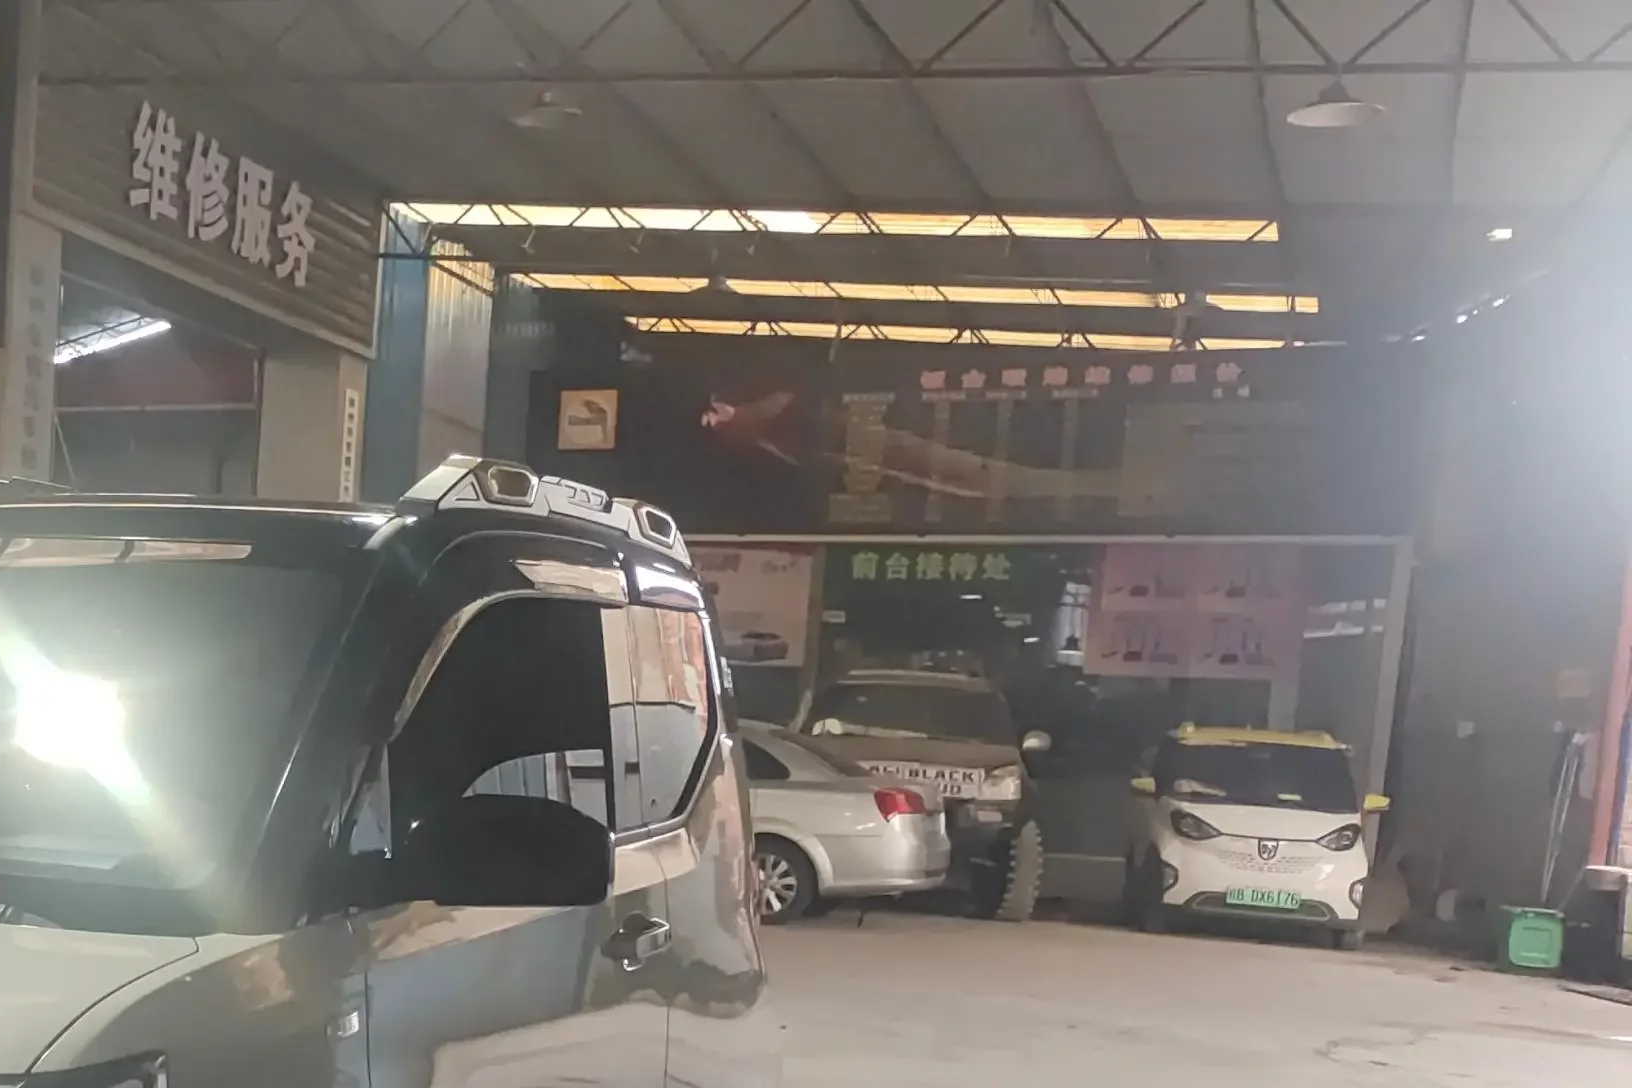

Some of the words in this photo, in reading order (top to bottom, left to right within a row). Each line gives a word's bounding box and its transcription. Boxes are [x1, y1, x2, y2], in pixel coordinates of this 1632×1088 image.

[129, 100, 316, 287] 维修服务
[851, 552, 1012, 582] 前台接待处
[909, 768, 975, 783] BLACK
